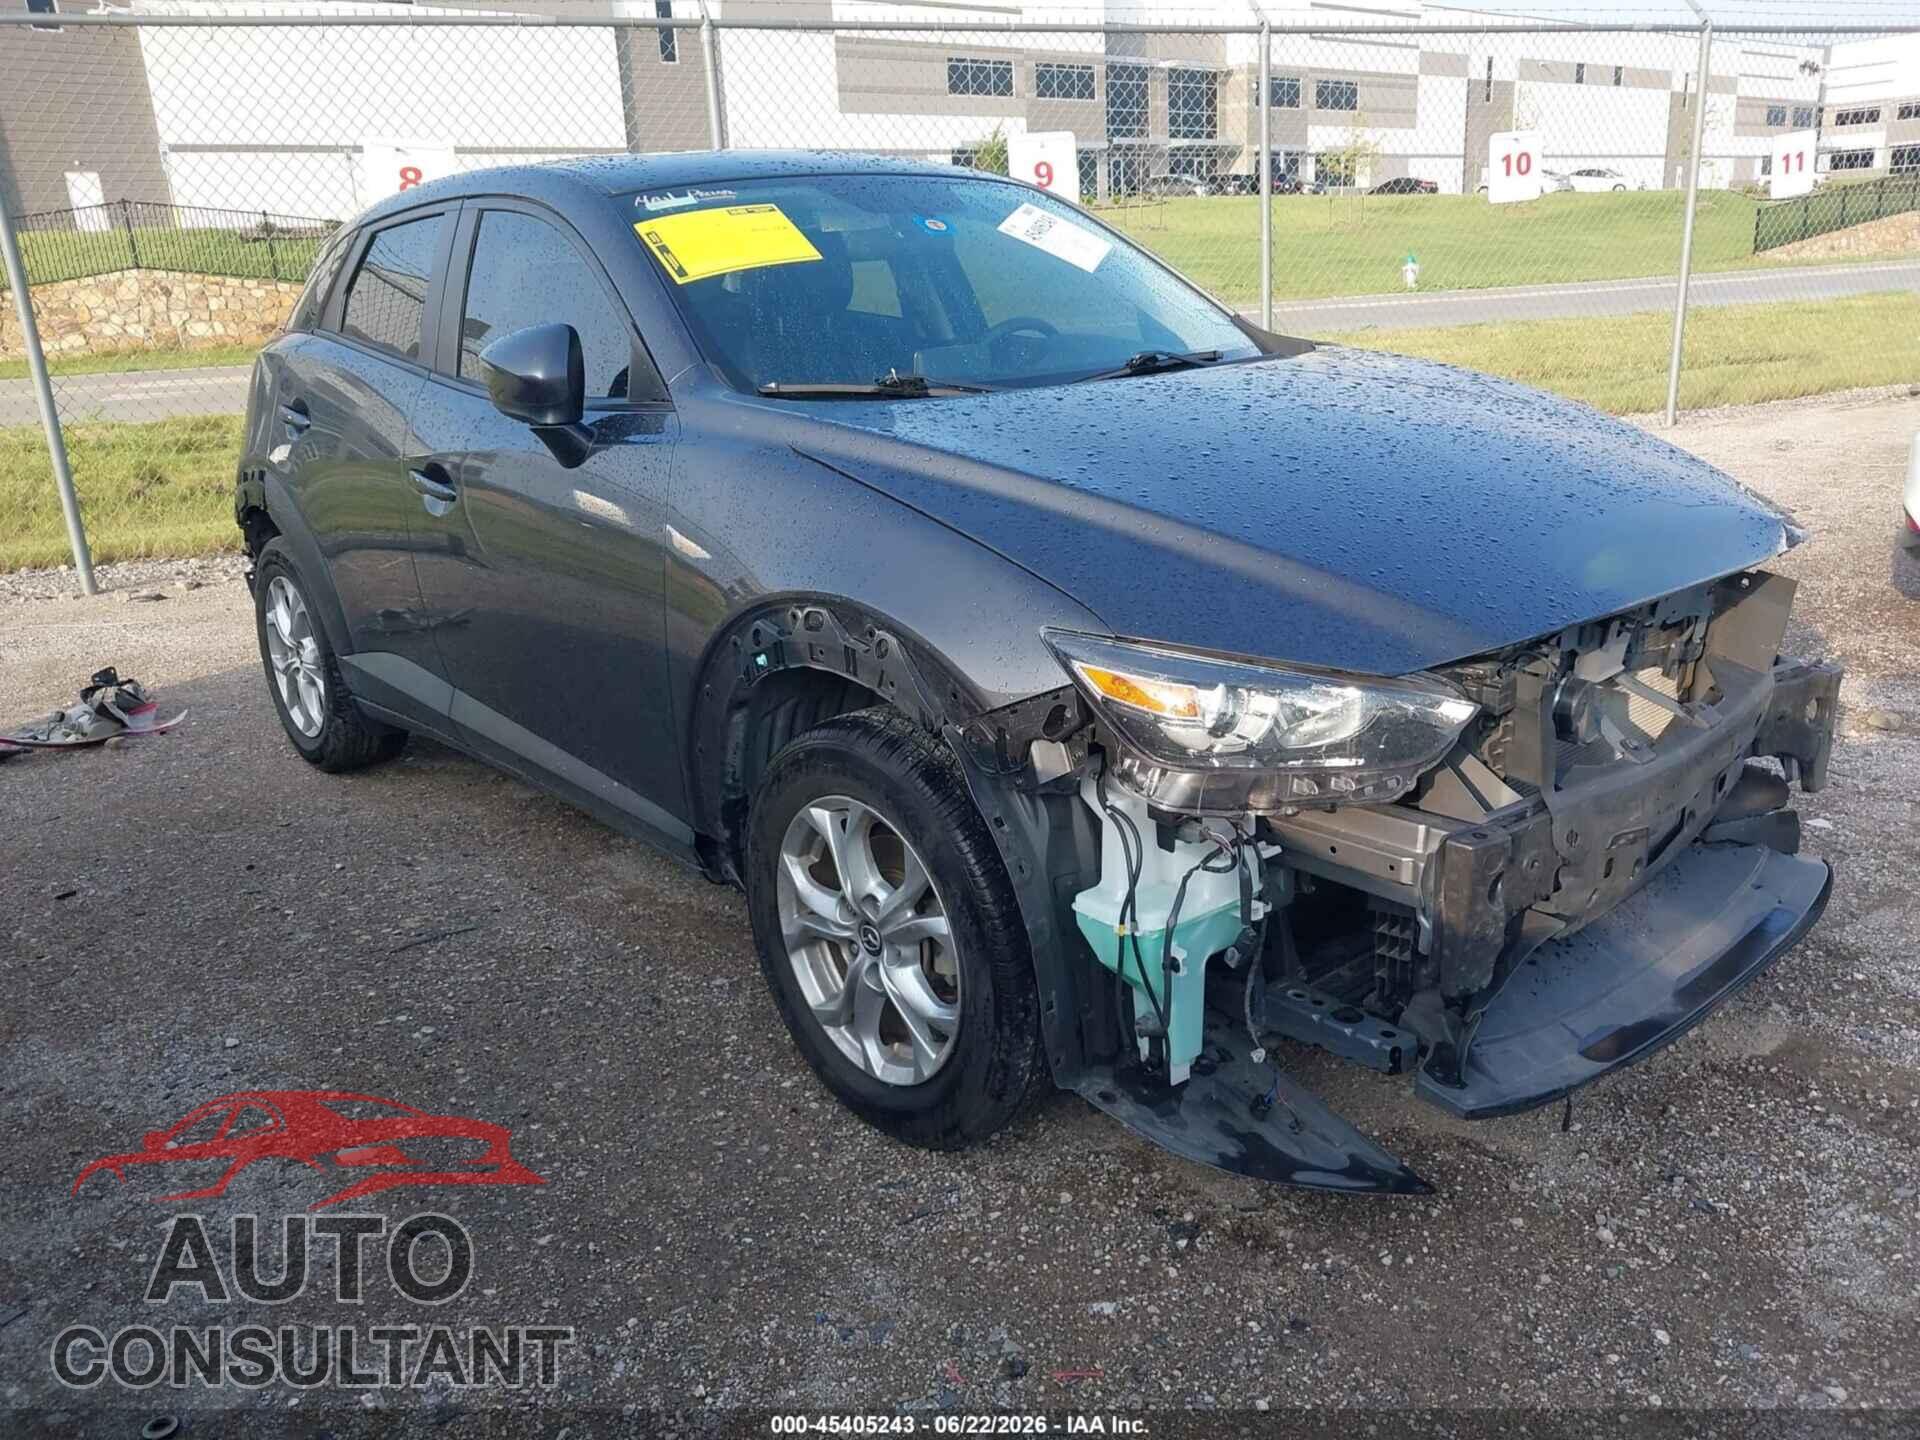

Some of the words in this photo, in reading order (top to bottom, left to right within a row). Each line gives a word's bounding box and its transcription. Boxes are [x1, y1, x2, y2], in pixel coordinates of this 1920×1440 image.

[1035, 161, 1054, 188] 9
[1501, 151, 1531, 176] 10
[1782, 151, 1804, 174] 11
